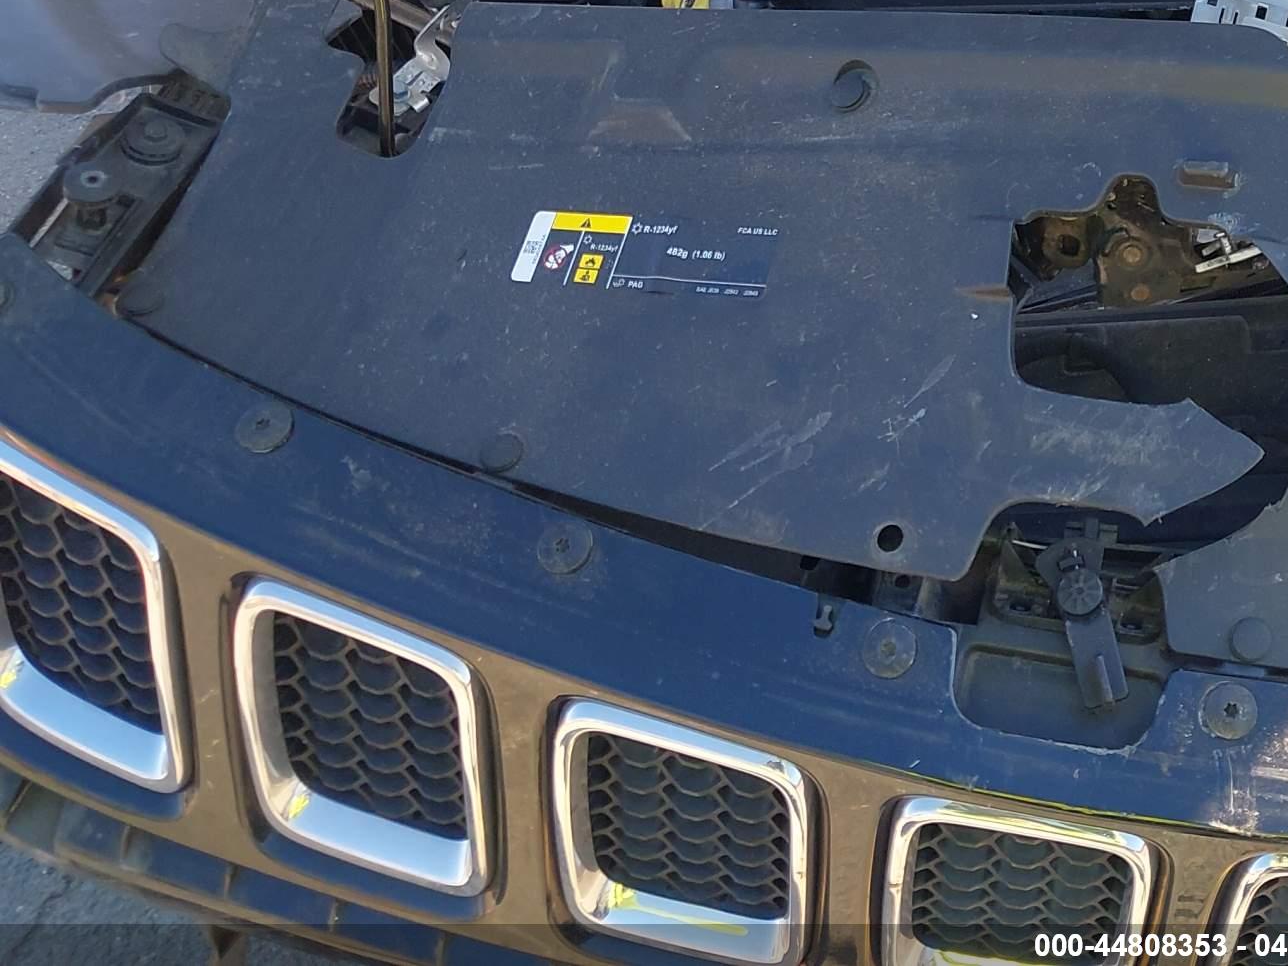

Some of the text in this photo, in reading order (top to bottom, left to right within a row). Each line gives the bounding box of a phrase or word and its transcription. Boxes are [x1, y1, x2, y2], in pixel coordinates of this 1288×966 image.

[643, 225, 679, 235] R-1234yf
[737, 227, 779, 236] FCA US LLC
[666, 246, 726, 262] 482g (1.06 lb)
